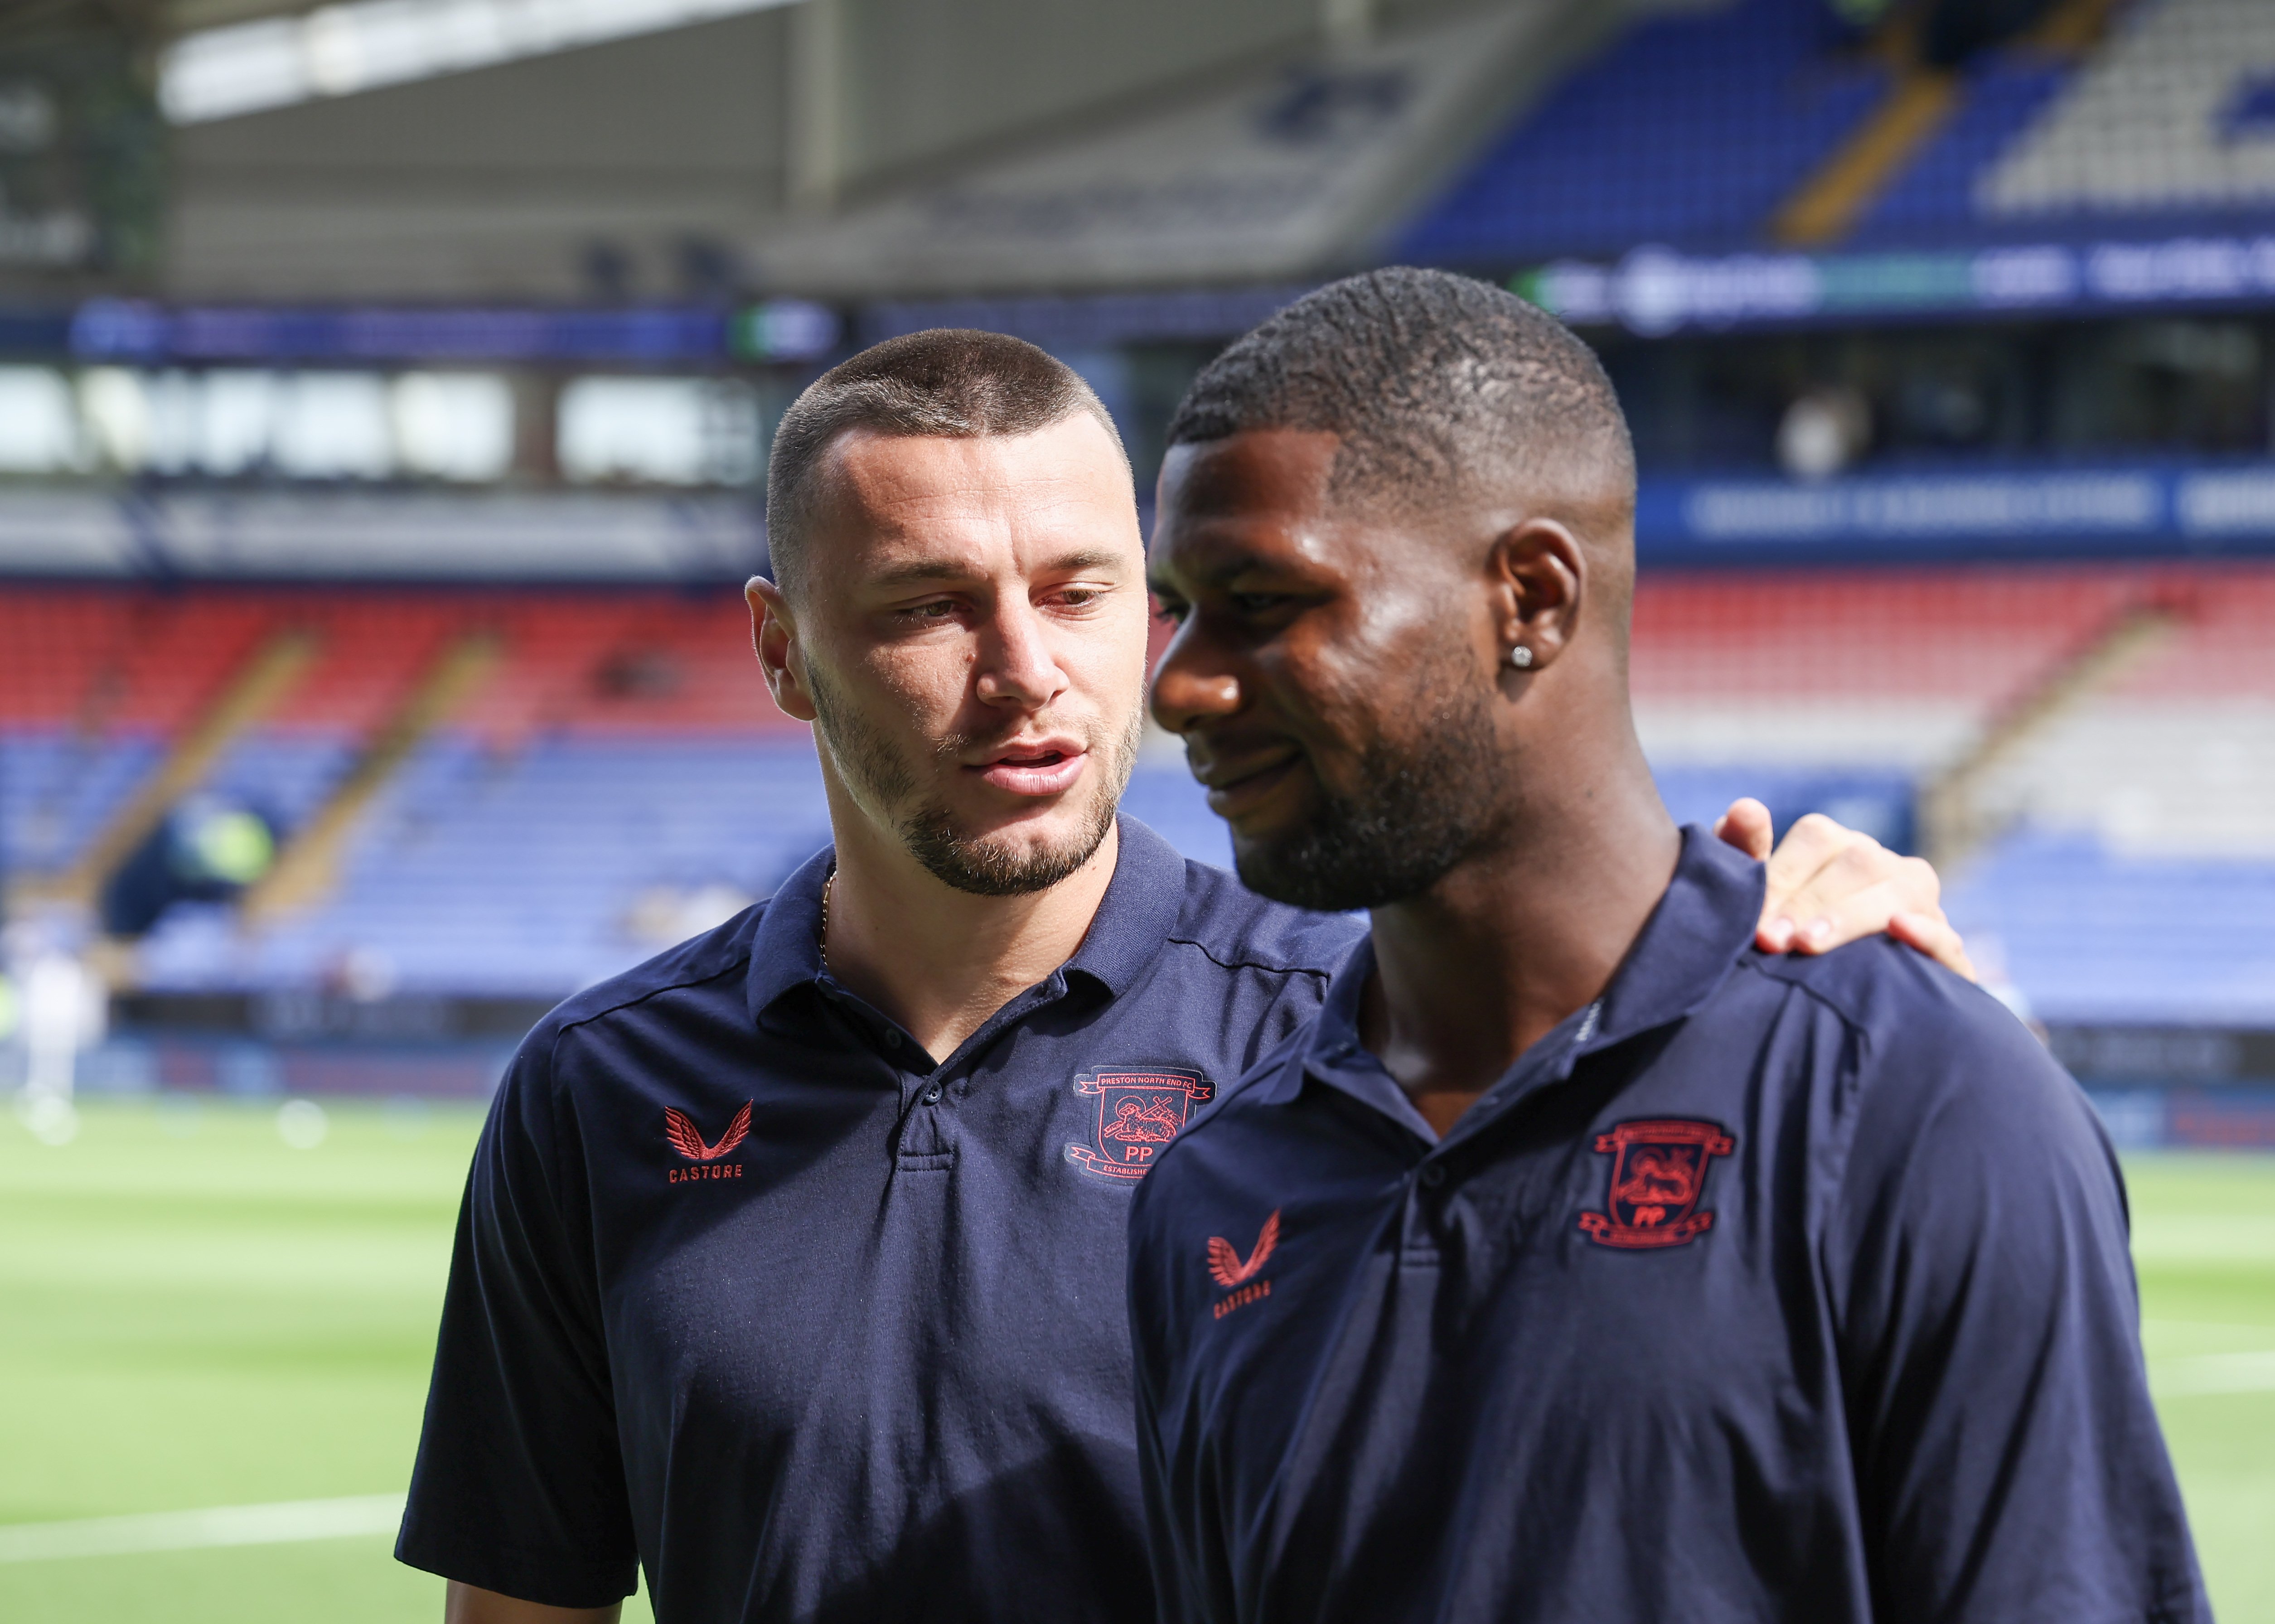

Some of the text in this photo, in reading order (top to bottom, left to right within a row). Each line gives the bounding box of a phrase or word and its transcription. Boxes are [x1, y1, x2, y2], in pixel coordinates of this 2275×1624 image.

[1125, 1146, 1153, 1162] PP
[669, 1165, 742, 1184] CASTORE
[1104, 1165, 1147, 1175] ESTABLISHE
[1633, 1206, 1666, 1228] PP
